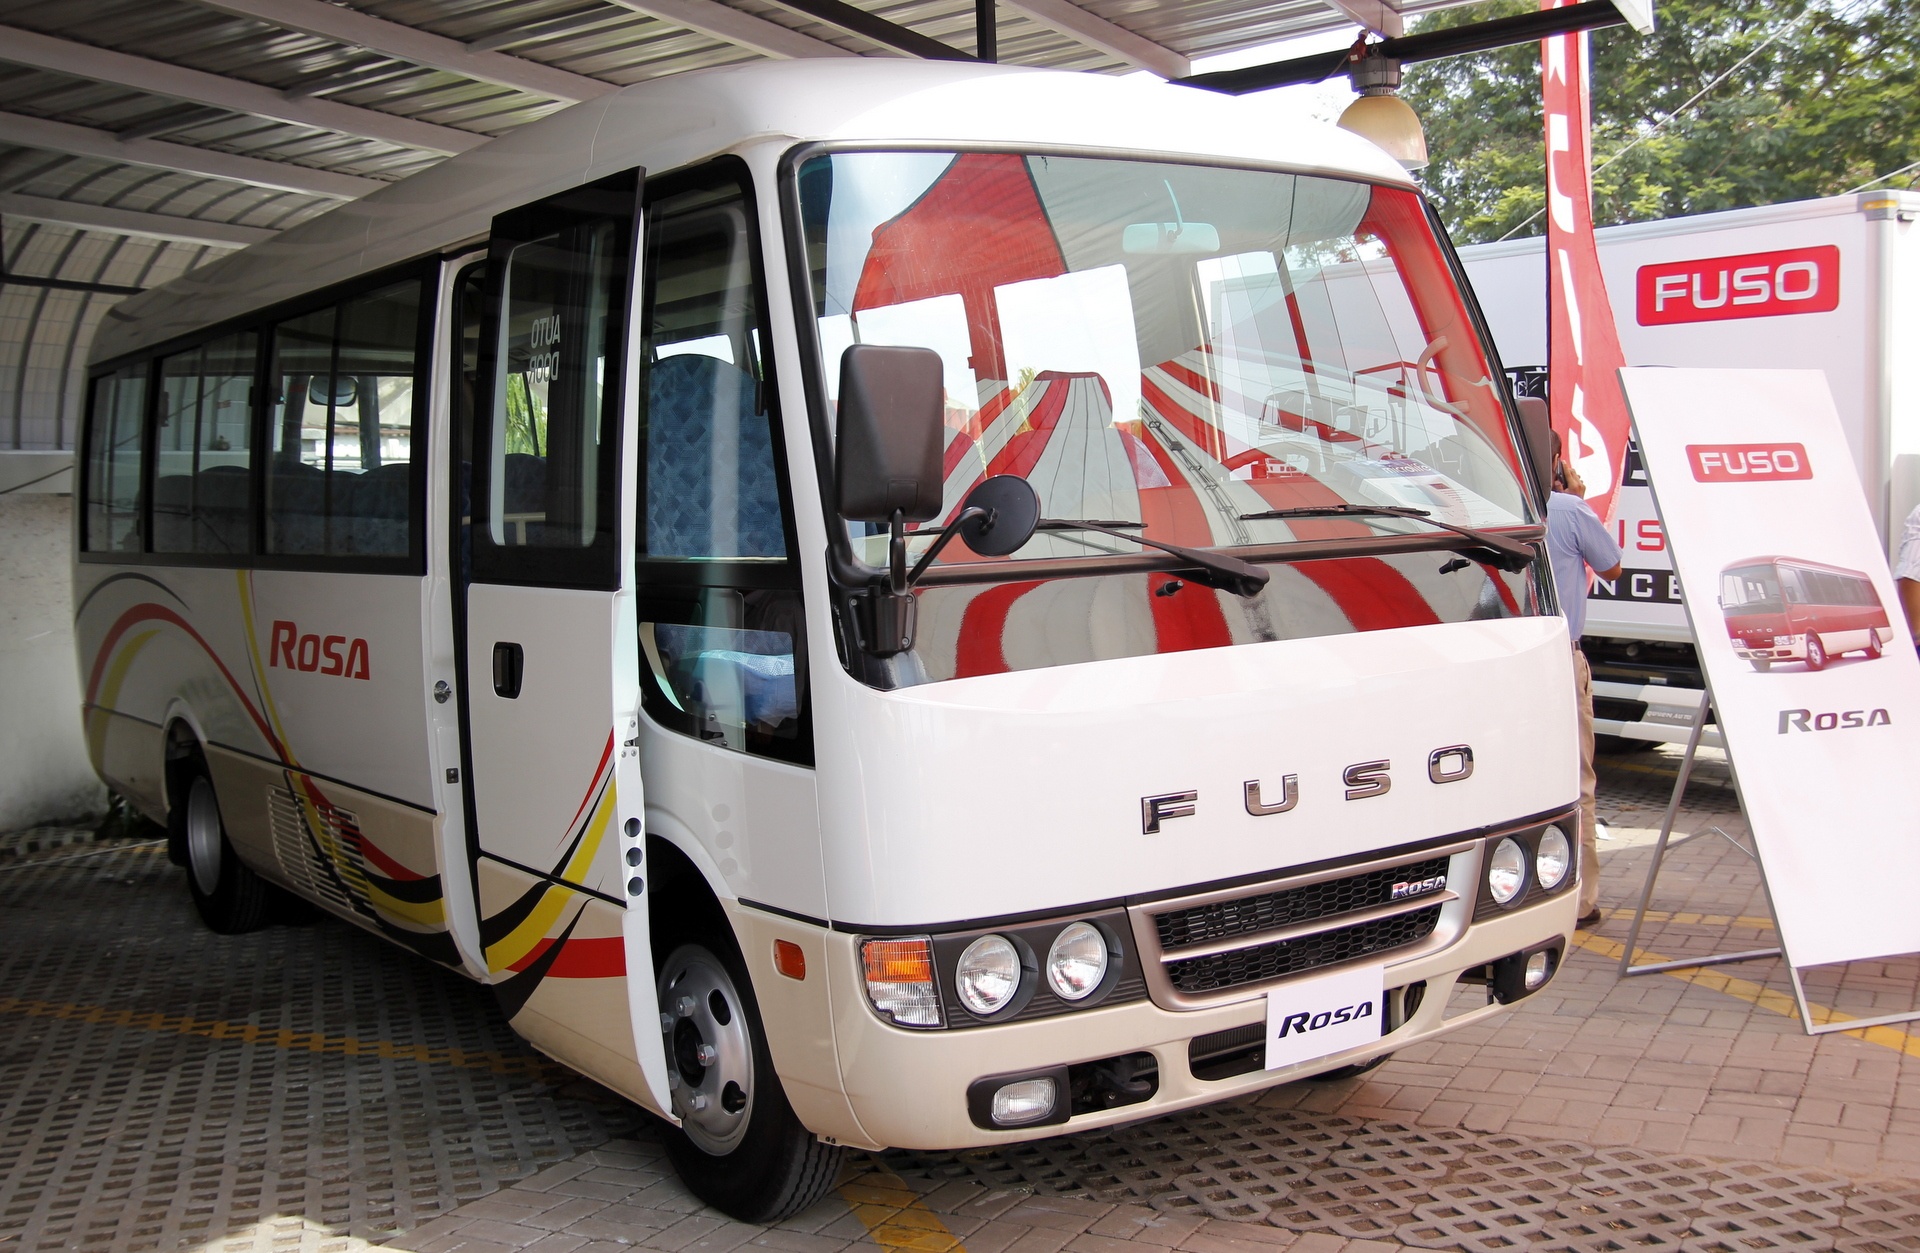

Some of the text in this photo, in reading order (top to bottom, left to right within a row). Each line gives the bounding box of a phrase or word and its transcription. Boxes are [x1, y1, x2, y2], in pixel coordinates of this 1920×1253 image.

[1655, 261, 1819, 312] FUSO
[1698, 450, 1800, 474] FUSO
[1141, 744, 1475, 835] FUSO
